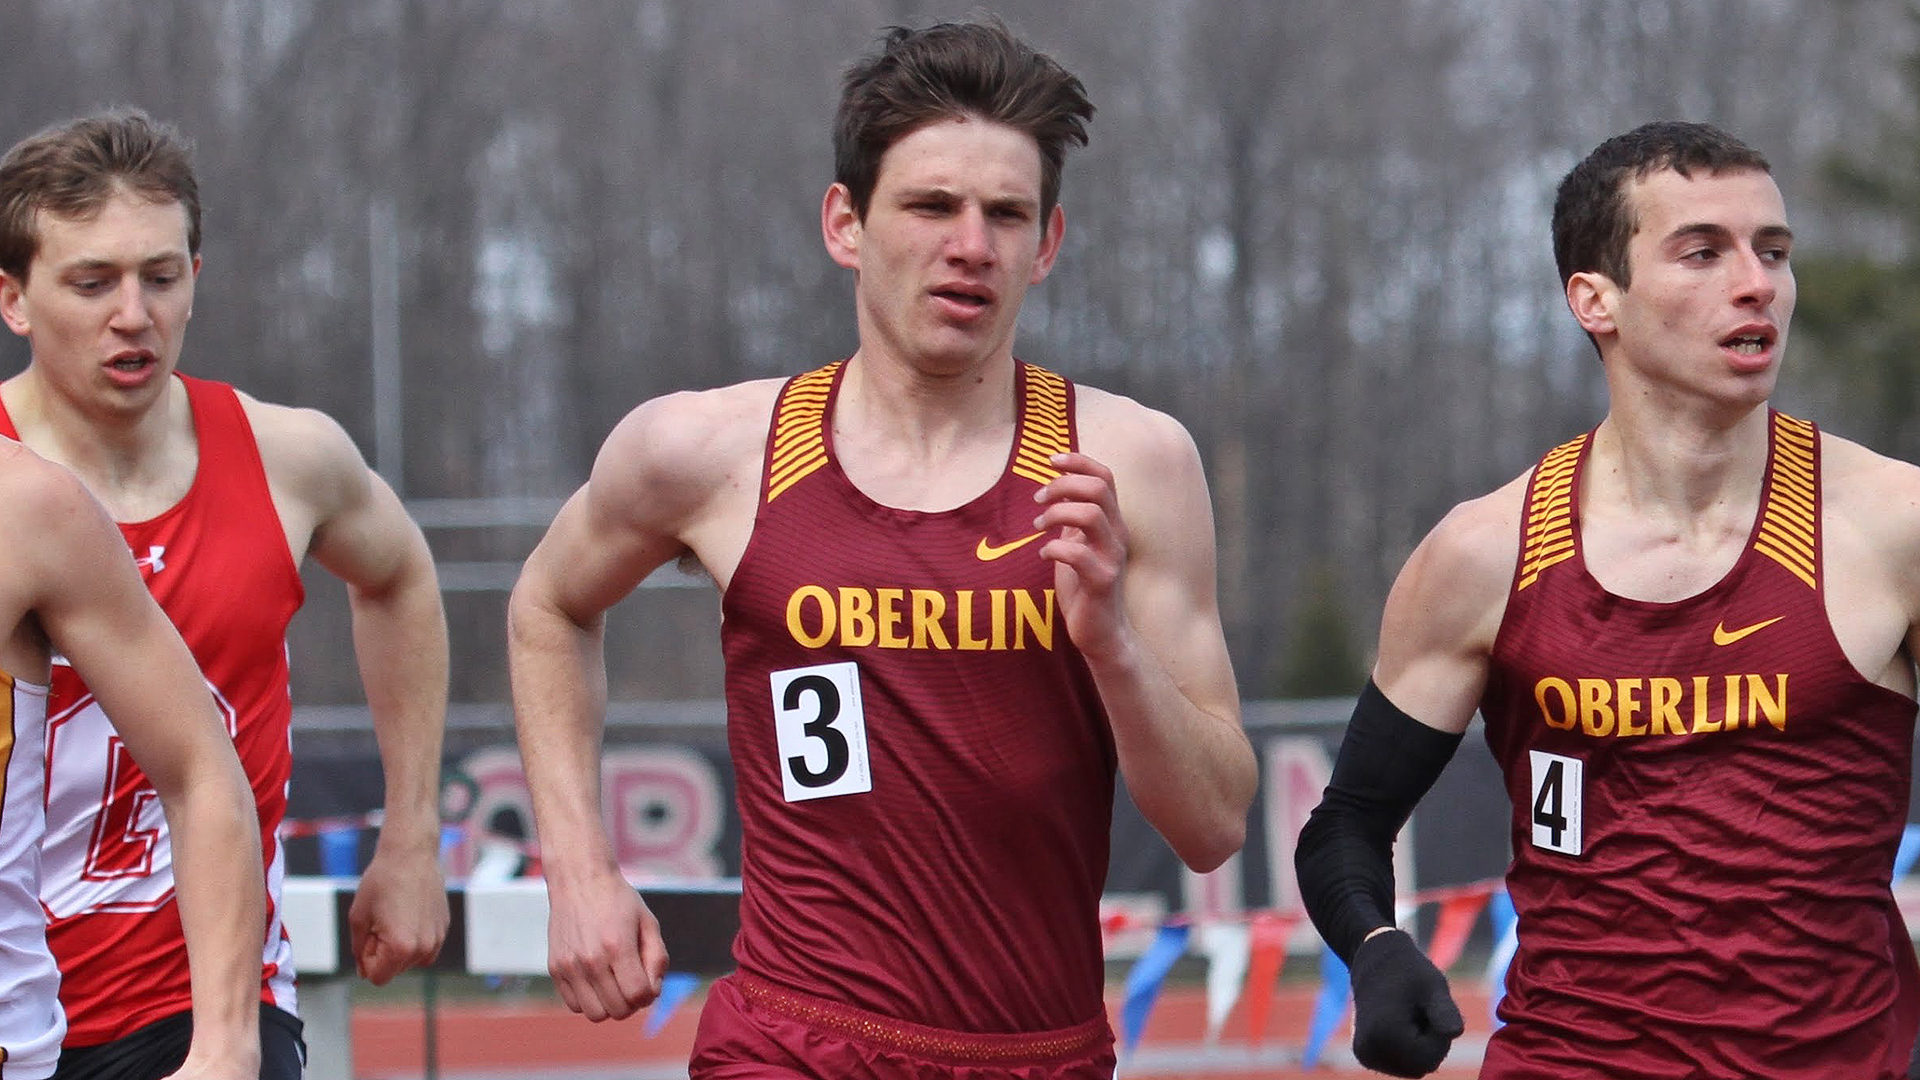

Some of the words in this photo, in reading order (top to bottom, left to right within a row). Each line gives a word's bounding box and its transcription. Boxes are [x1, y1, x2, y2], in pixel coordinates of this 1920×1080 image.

[786, 585, 1054, 651] OBERLIN
[783, 675, 849, 787] 3
[1535, 673, 1789, 737] OBERLIN
[1533, 760, 1567, 847] 4
